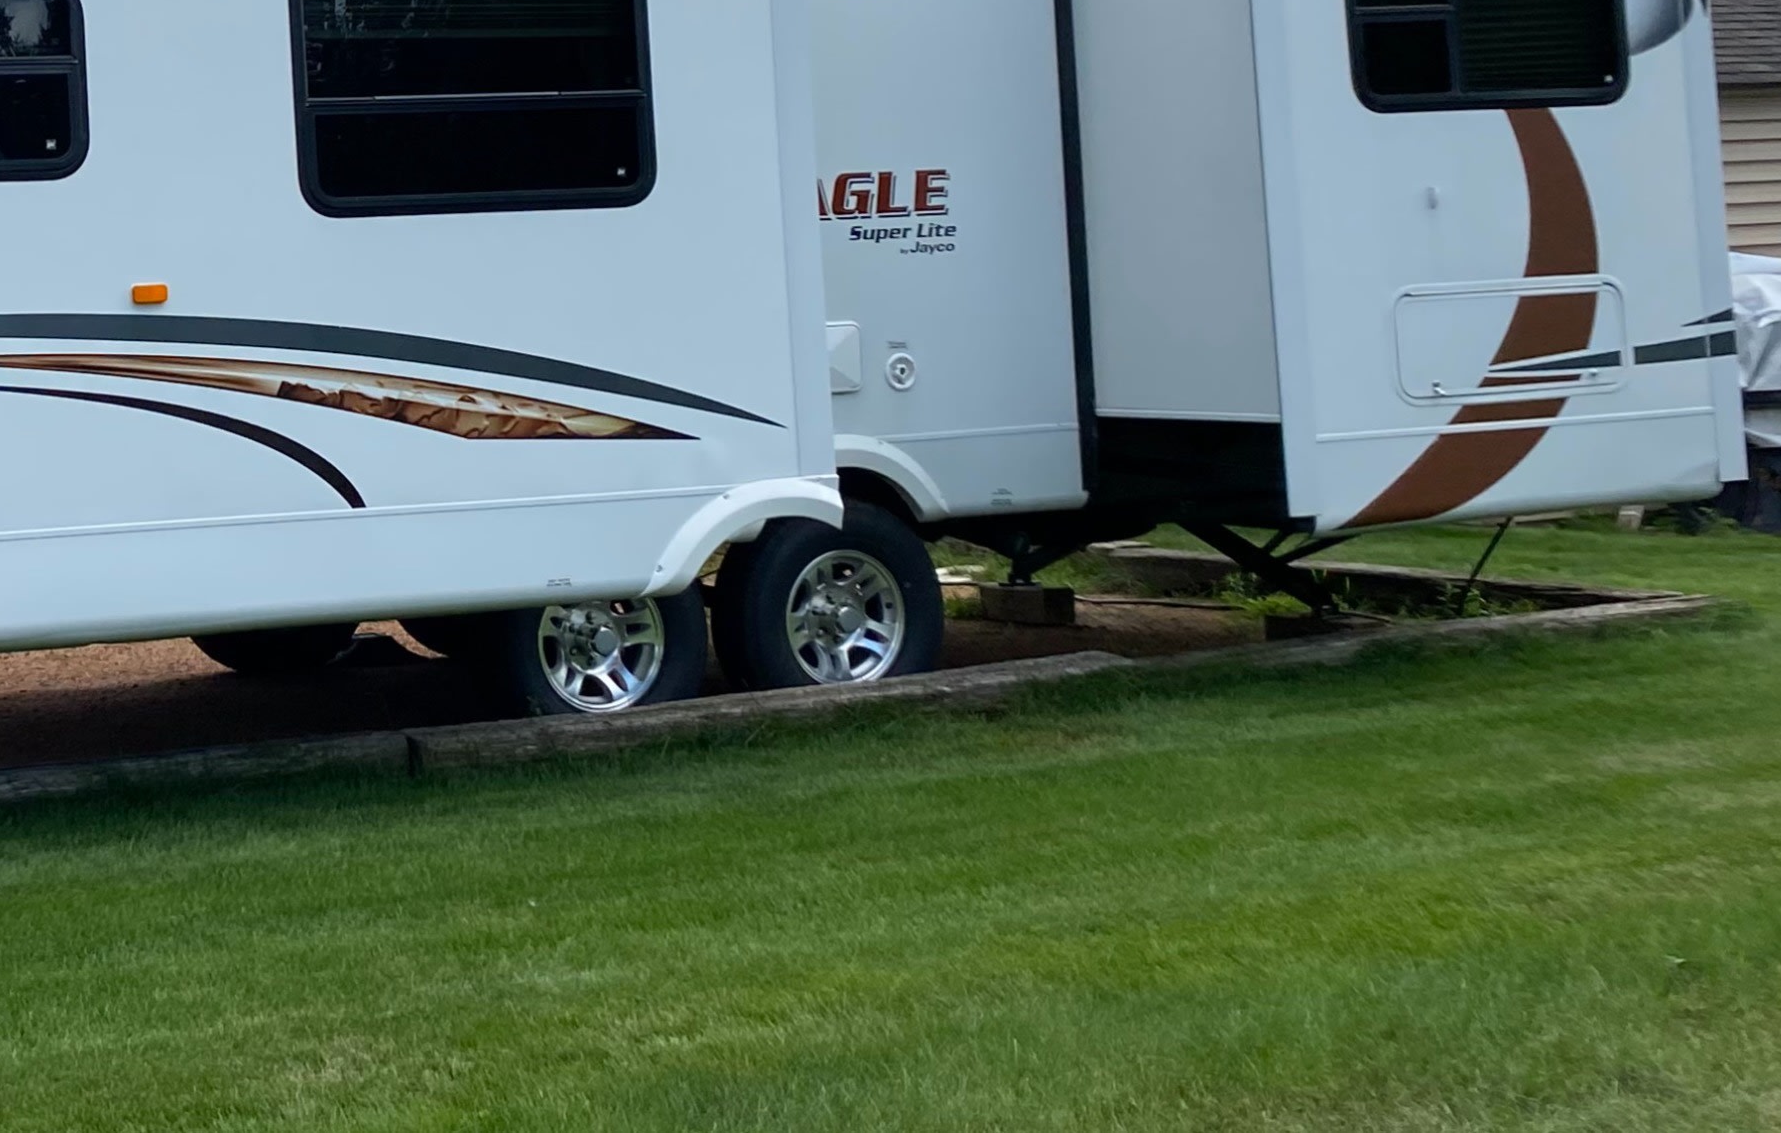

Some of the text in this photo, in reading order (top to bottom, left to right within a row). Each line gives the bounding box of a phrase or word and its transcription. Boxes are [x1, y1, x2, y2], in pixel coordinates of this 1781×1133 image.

[849, 223, 957, 243] Super Lite
[910, 241, 955, 255] Jayco
